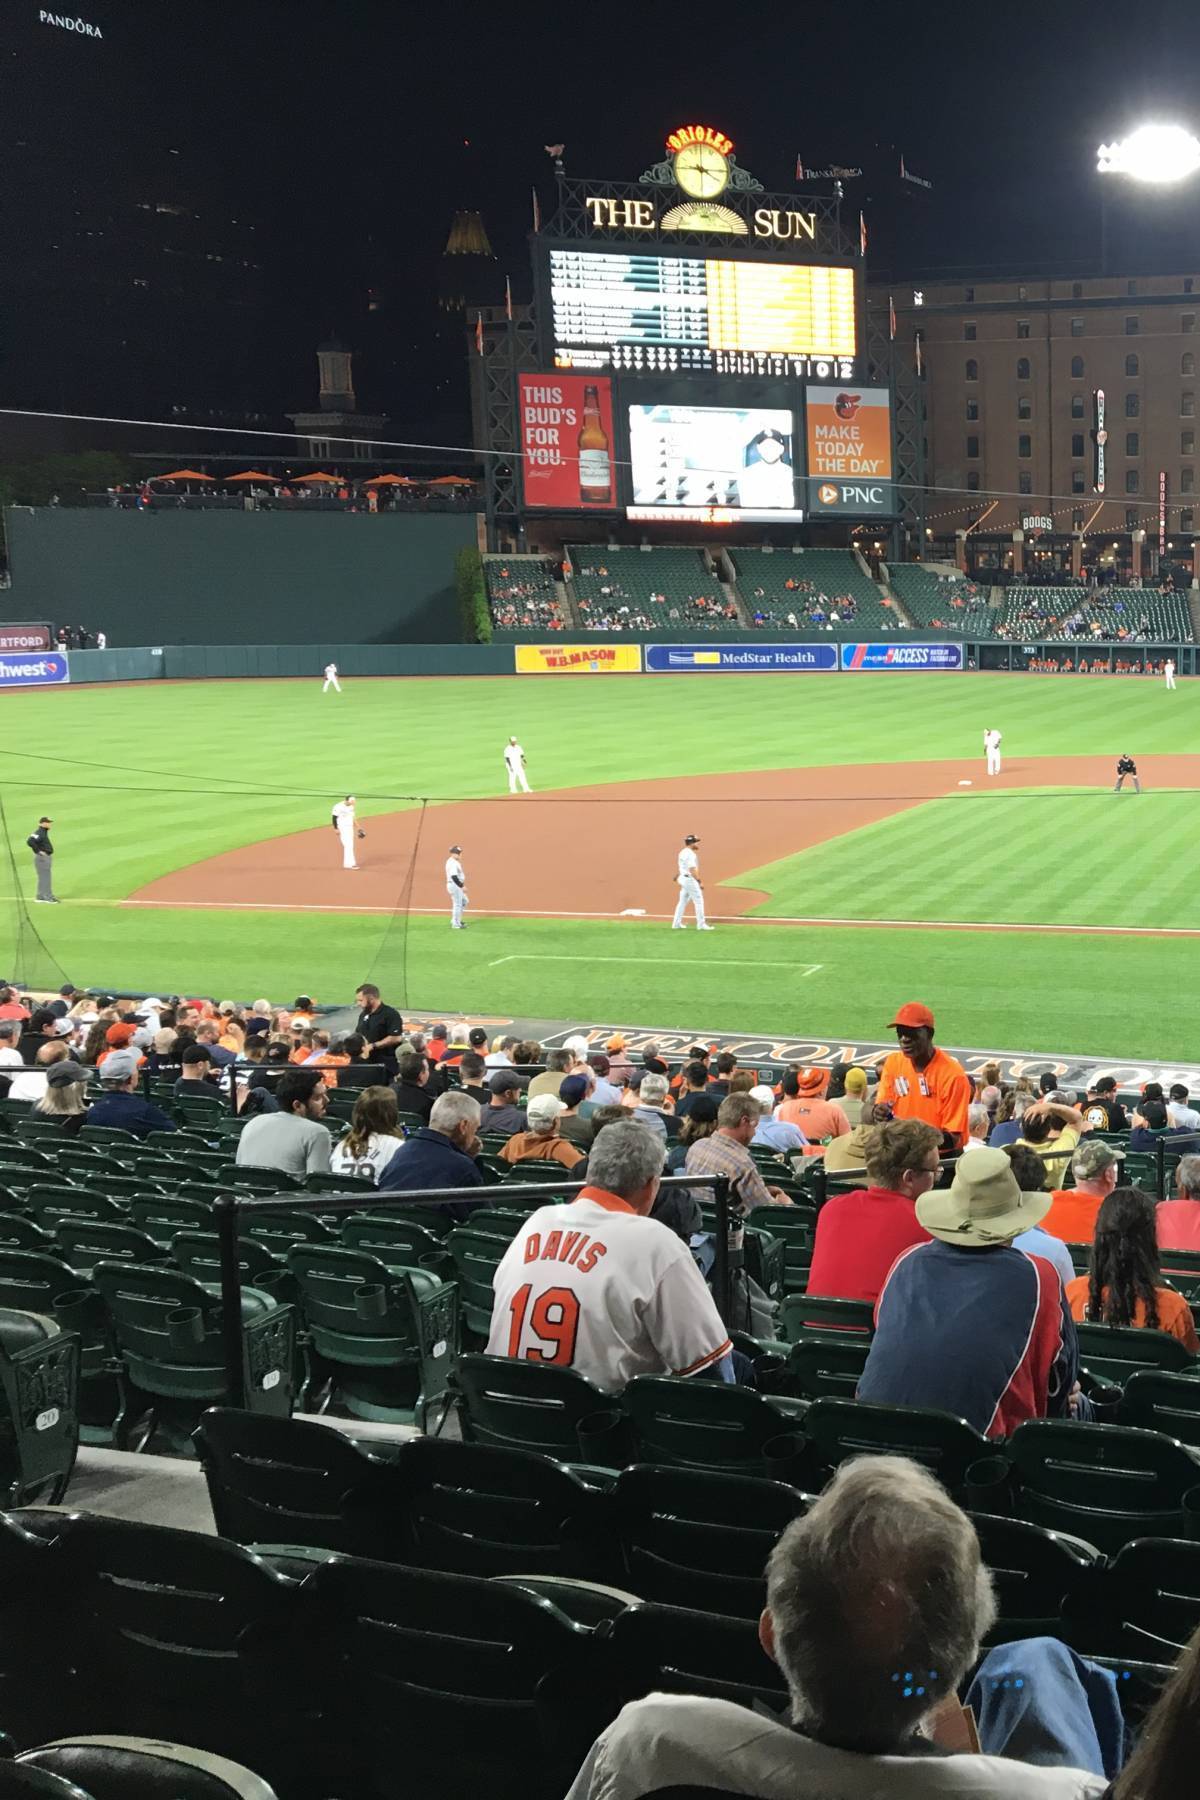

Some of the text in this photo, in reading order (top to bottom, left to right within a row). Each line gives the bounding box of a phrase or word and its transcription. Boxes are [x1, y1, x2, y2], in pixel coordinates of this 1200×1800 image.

[667, 125, 734, 154] ORIOLES
[586, 197, 816, 240] THE SUN
[523, 386, 563, 404] THIS
[524, 407, 577, 425] BUD'S
[526, 428, 559, 445] FOR
[815, 425, 860, 440] MAKE
[526, 448, 566, 465] YOU.
[816, 442, 864, 457] TODAY
[816, 459, 880, 474] THE DAY
[842, 487, 883, 504] PNC
[1023, 516, 1052, 530] BOOGS
[722, 652, 816, 663] MedStar Health
[892, 648, 929, 663] ACCESS
[524, 1230, 607, 1273] DAVIS
[508, 1283, 581, 1367] 19
[41, 1412, 56, 1428] 20
